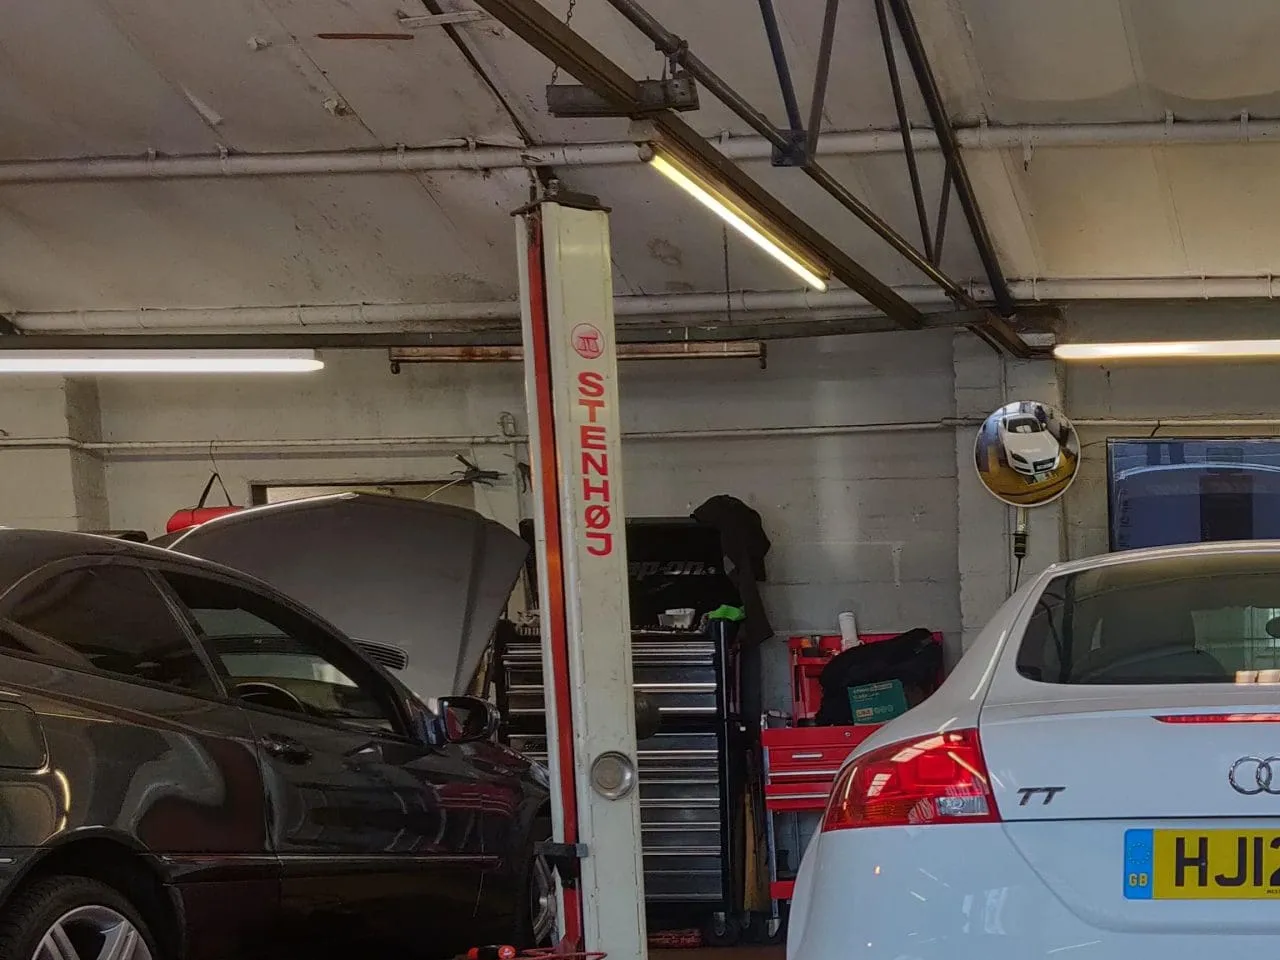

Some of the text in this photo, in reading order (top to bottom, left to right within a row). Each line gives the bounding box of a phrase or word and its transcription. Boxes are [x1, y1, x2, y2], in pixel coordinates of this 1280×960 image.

[577, 371, 613, 556] STENHØJ
[1016, 786, 1067, 806] TT
[1128, 873, 1148, 887] GB
